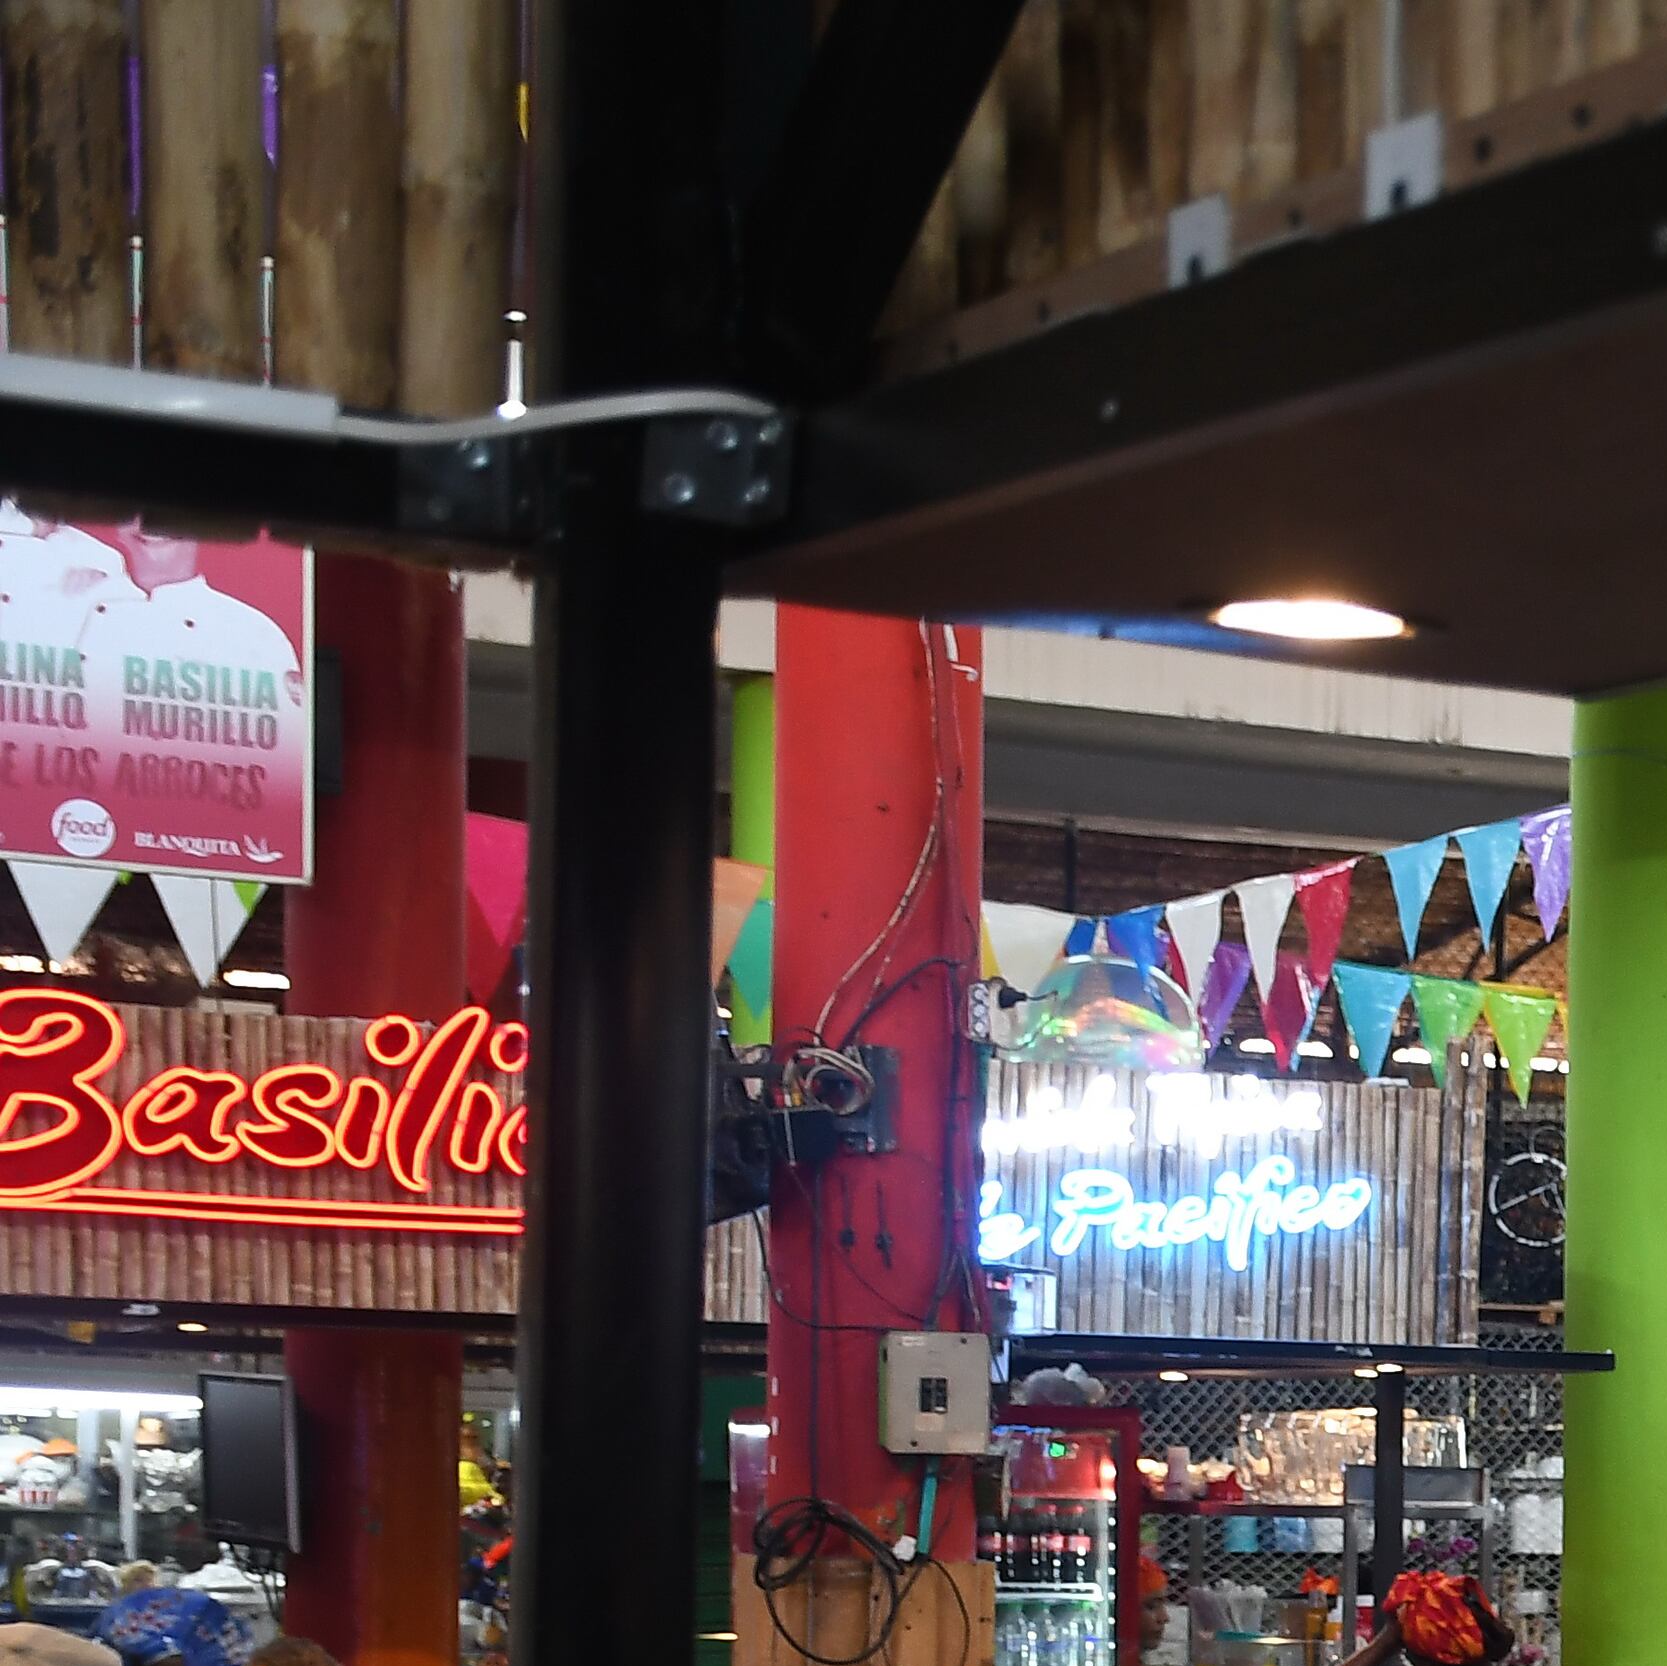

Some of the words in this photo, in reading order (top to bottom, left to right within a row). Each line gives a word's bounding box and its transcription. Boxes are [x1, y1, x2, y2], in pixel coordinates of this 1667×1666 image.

[123, 654, 278, 710] BASILIA
[122, 698, 278, 750] MURILLO
[34, 743, 99, 793] LOS
[113, 752, 267, 810] ARROCES
[58, 812, 111, 840] food
